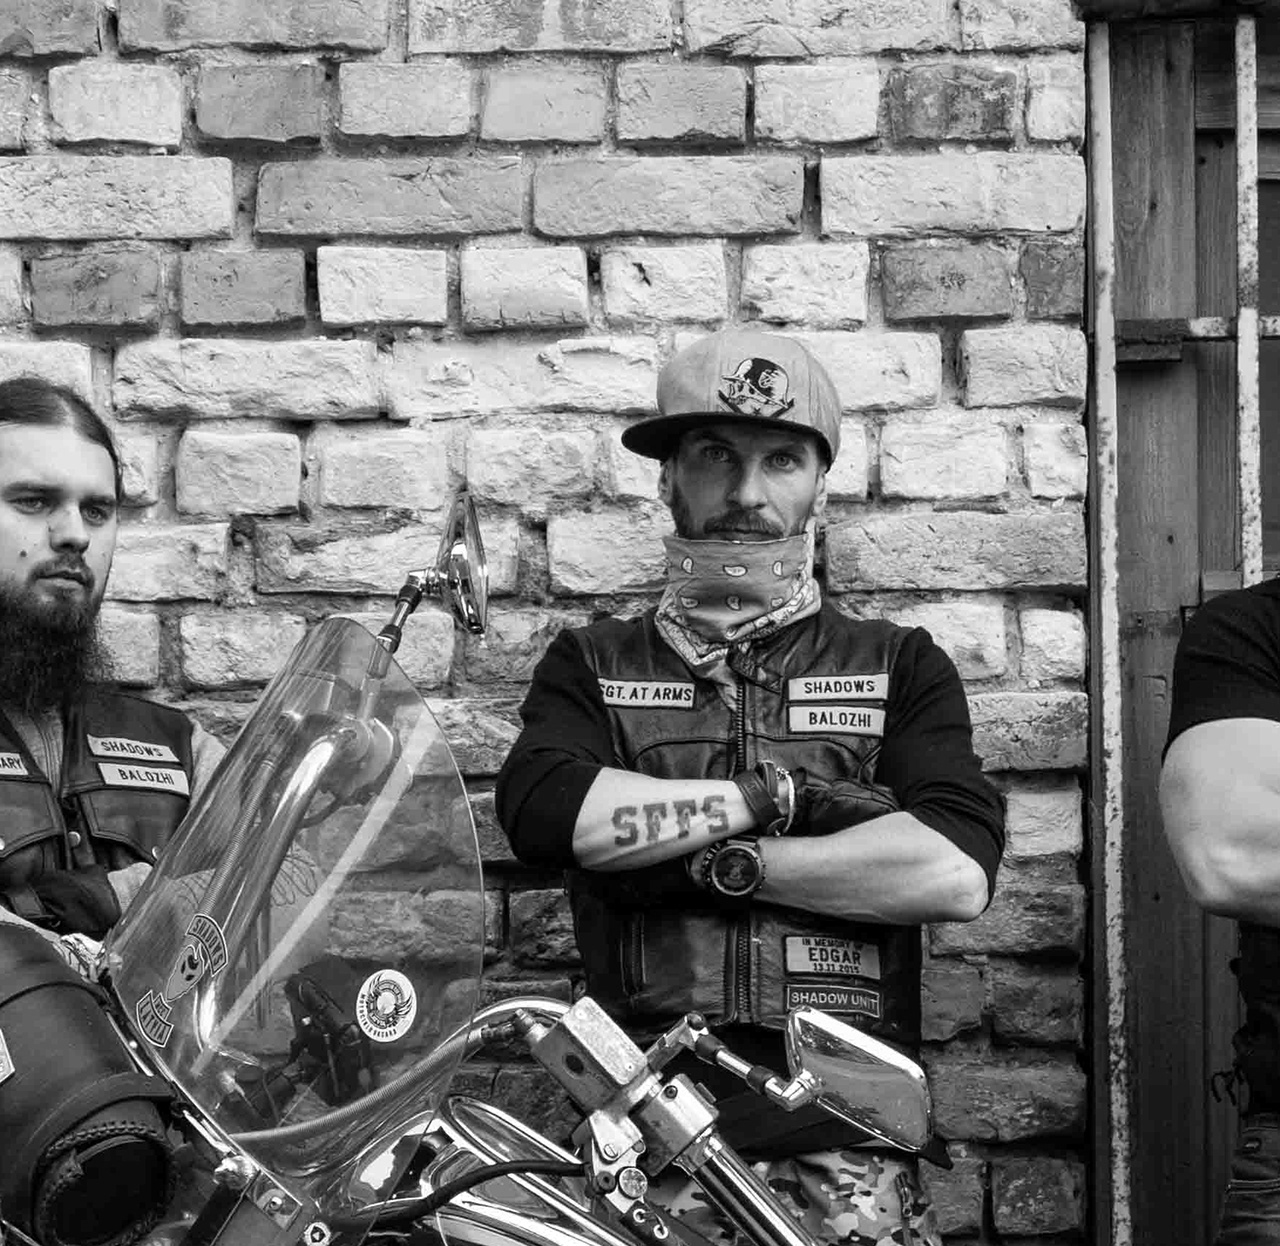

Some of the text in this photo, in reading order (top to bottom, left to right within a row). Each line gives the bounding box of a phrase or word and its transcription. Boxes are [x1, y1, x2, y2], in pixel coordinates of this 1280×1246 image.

[629, 686, 649, 701] AT
[652, 686, 693, 701] ARMS
[804, 680, 876, 694] SHADOWS
[808, 711, 871, 728] BALOZHI
[100, 741, 164, 757] SHADOWS
[118, 768, 175, 785] BALOZHI
[192, 918, 224, 967] SHADOWS
[808, 947, 861, 965] EDGAR
[791, 992, 879, 1010] SHADOW UNIT
[140, 1000, 167, 1041] LATVIA
